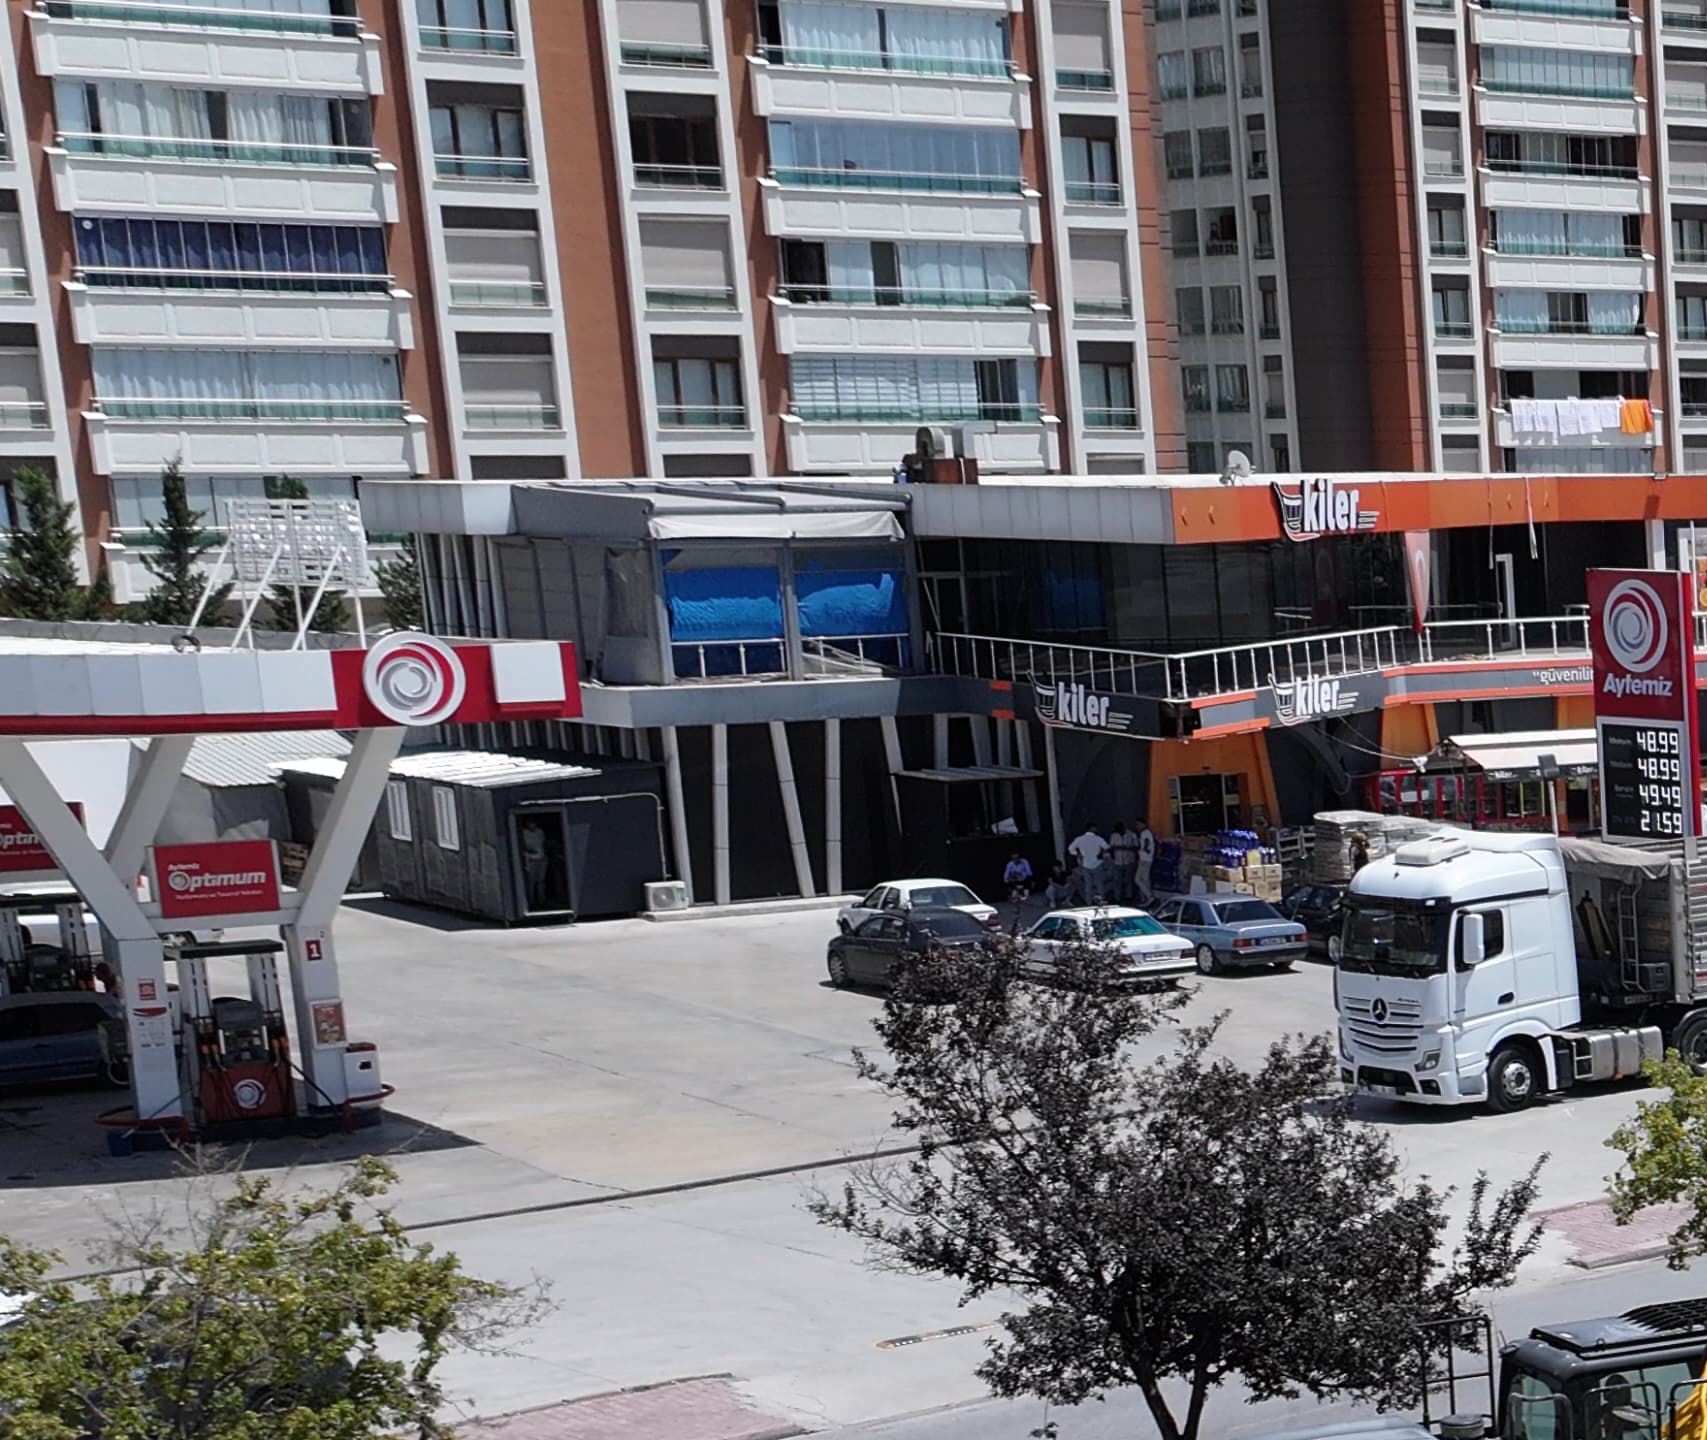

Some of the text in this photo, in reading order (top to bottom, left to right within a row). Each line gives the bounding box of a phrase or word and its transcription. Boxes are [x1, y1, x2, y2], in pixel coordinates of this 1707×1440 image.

[1303, 479, 1360, 531] kiler
[1295, 675, 1341, 716] kiler
[1603, 673, 1673, 698] Aytemiz
[1058, 682, 1110, 727] kiler
[1636, 731, 1679, 754] 48.99
[1637, 758, 1680, 781] 48.99
[1639, 784, 1682, 807] 49.49
[168, 871, 266, 892] Optimum
[310, 943, 321, 957] 1
